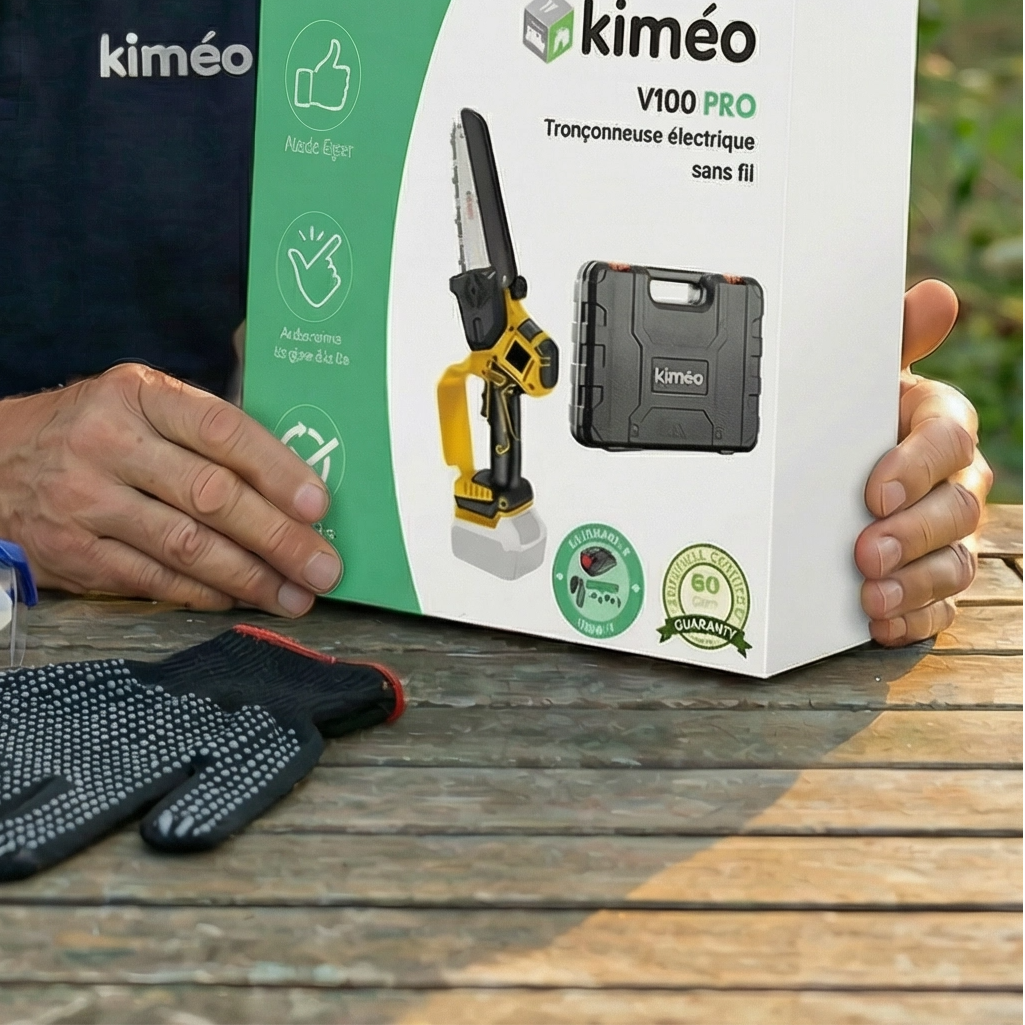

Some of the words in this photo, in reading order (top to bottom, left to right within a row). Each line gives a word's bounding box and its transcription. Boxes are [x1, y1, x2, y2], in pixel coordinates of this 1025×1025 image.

[100, 30, 253, 78] kiméo
[637, 86, 697, 115] V100
[703, 90, 757, 119] PRO
[544, 118, 663, 143] Tronçonneuse
[668, 126, 755, 153] électrique
[692, 164, 733, 181] sans
[738, 163, 754, 182] fil
[674, 617, 737, 639] GUARANTY
